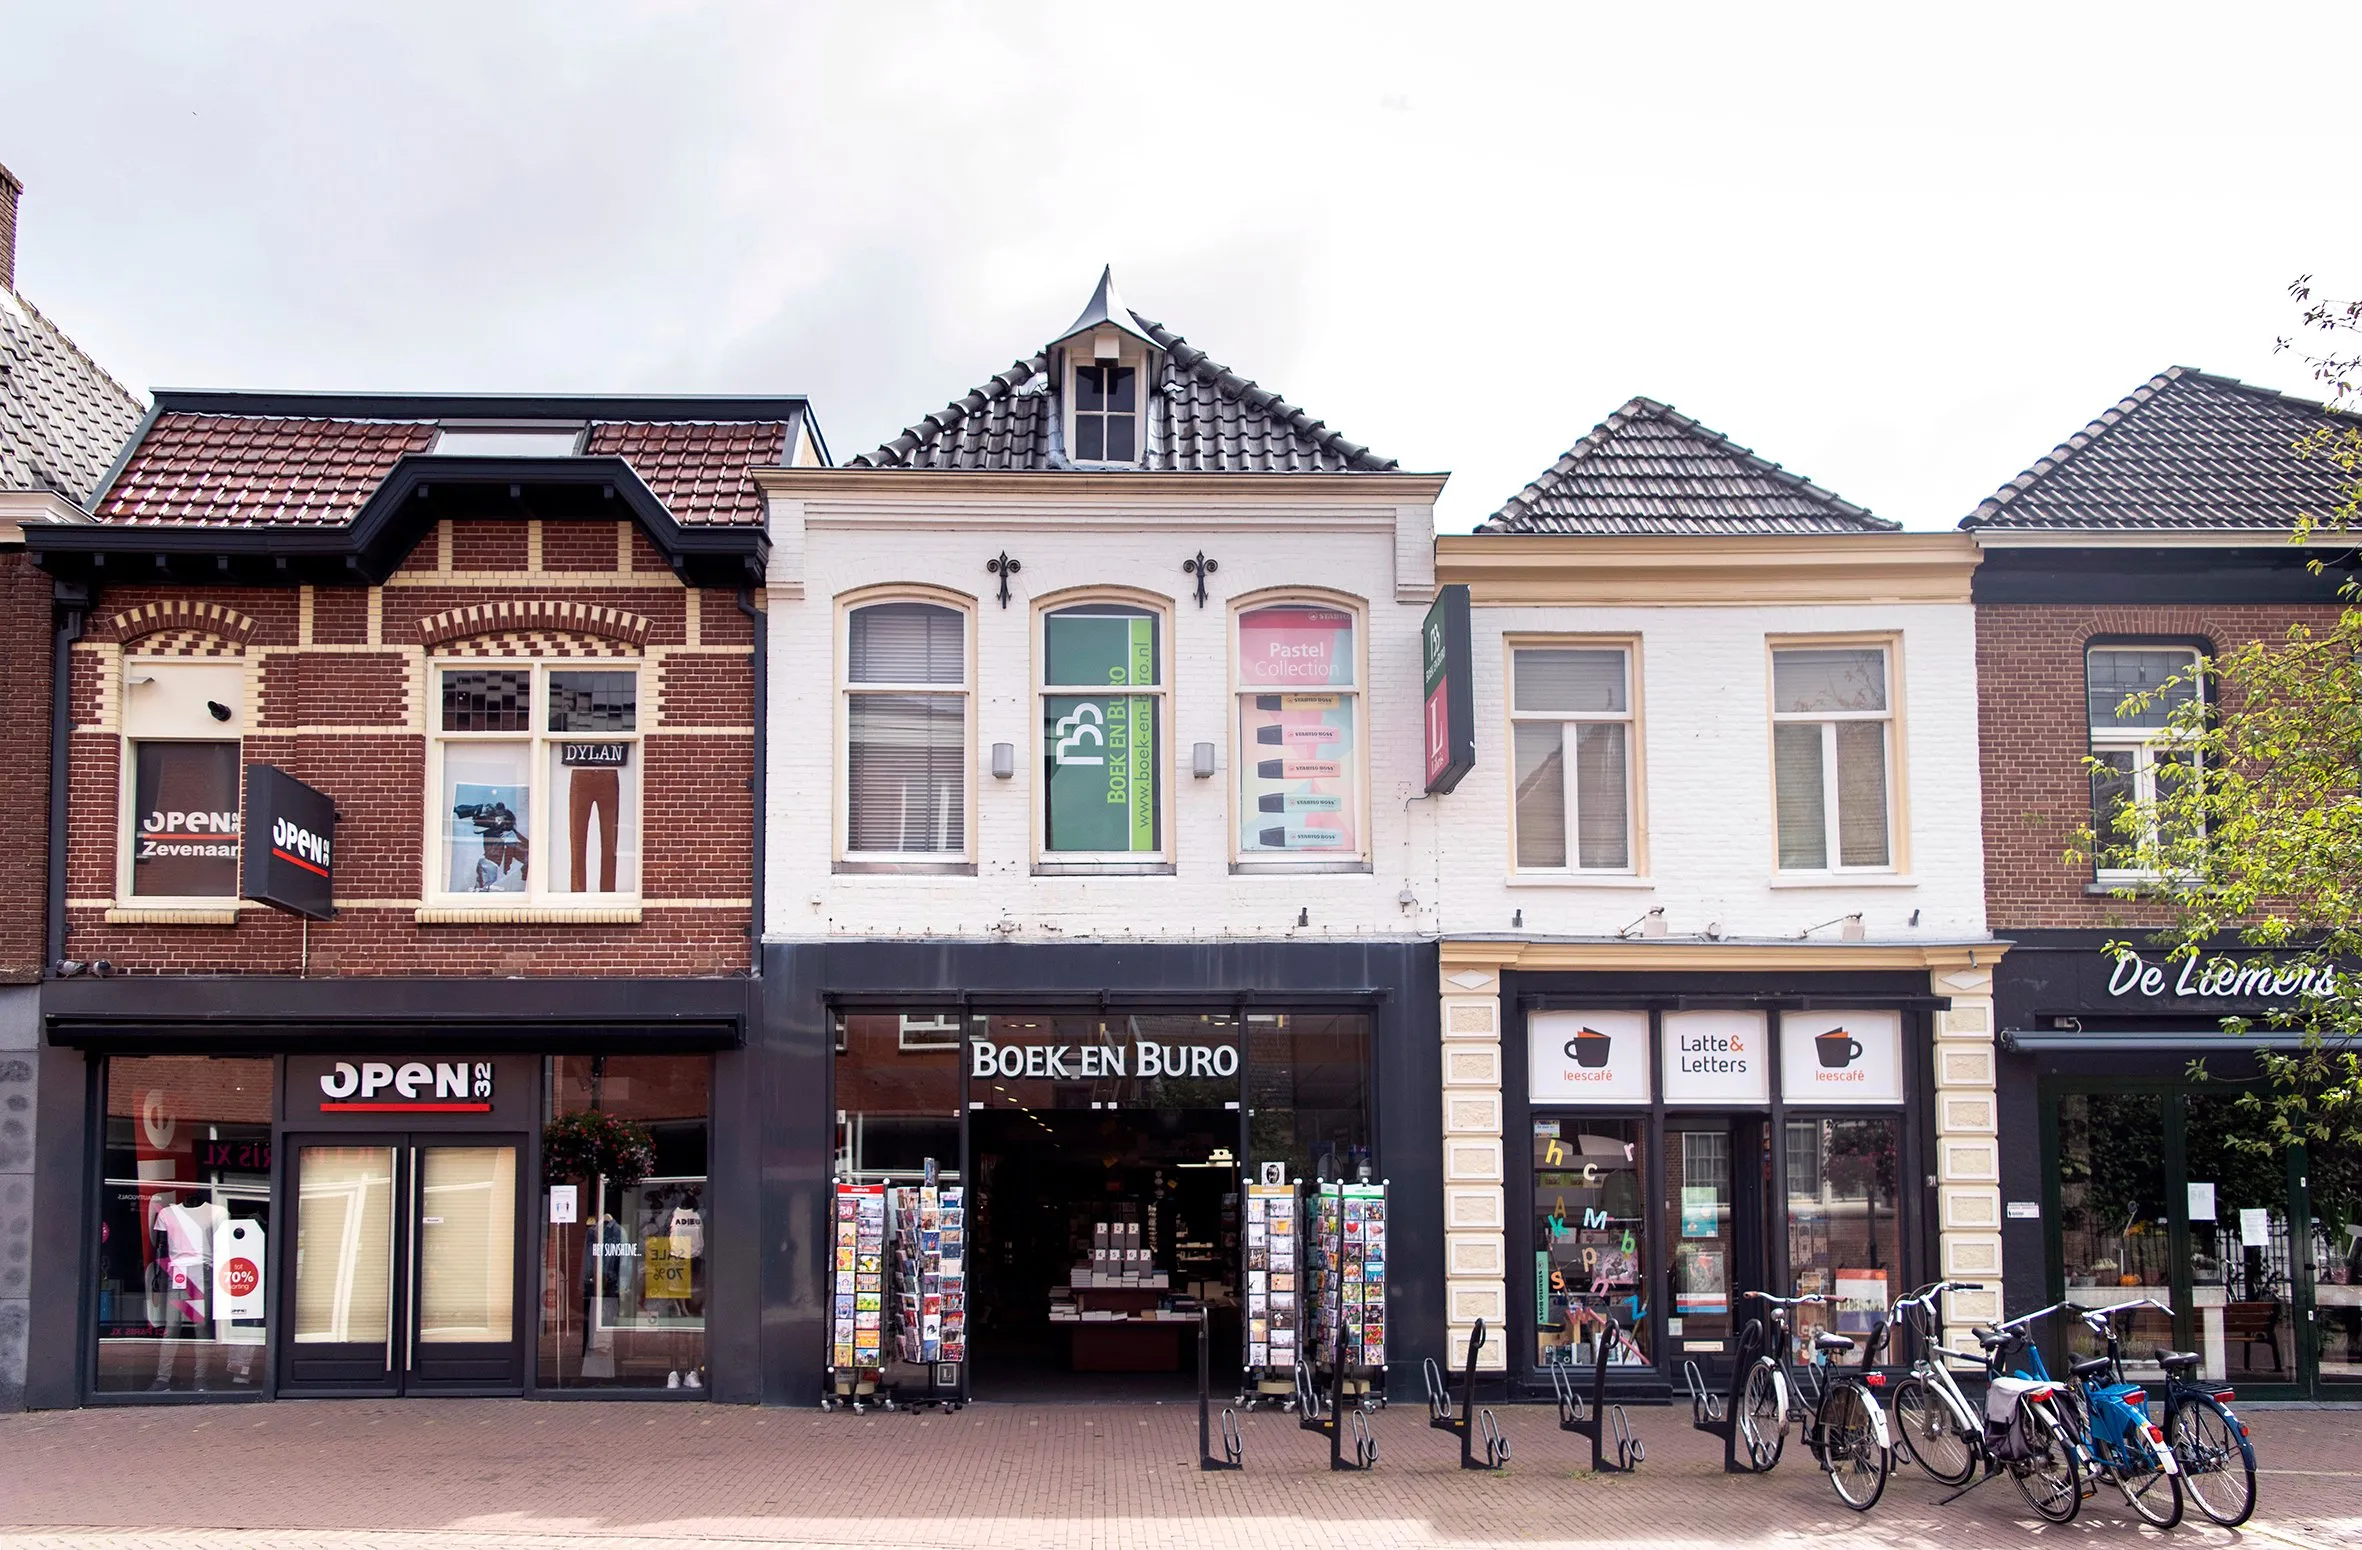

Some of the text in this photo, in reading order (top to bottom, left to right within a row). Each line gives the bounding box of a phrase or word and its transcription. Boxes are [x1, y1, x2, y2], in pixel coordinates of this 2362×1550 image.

[1270, 642, 1324, 658] Pastel
[1255, 659, 1339, 677] Collection
[1109, 724, 1127, 748] EN
[1134, 642, 1150, 828] www.boek-en-bro.nl
[565, 744, 624, 761] DYLAN
[1107, 753, 1127, 804] BOEK
[142, 841, 237, 857] Zevenaar
[2108, 952, 2337, 998] De Liemers
[971, 1041, 1239, 1078] BOEK EN BURO
[1681, 1055, 1747, 1073] Letters
[474, 1062, 492, 1098] 32
[1563, 1070, 1613, 1081] leescafé
[1815, 1069, 1865, 1081] leescafé
[592, 1243, 603, 1257] HEY
[223, 1270, 254, 1283] 70%
